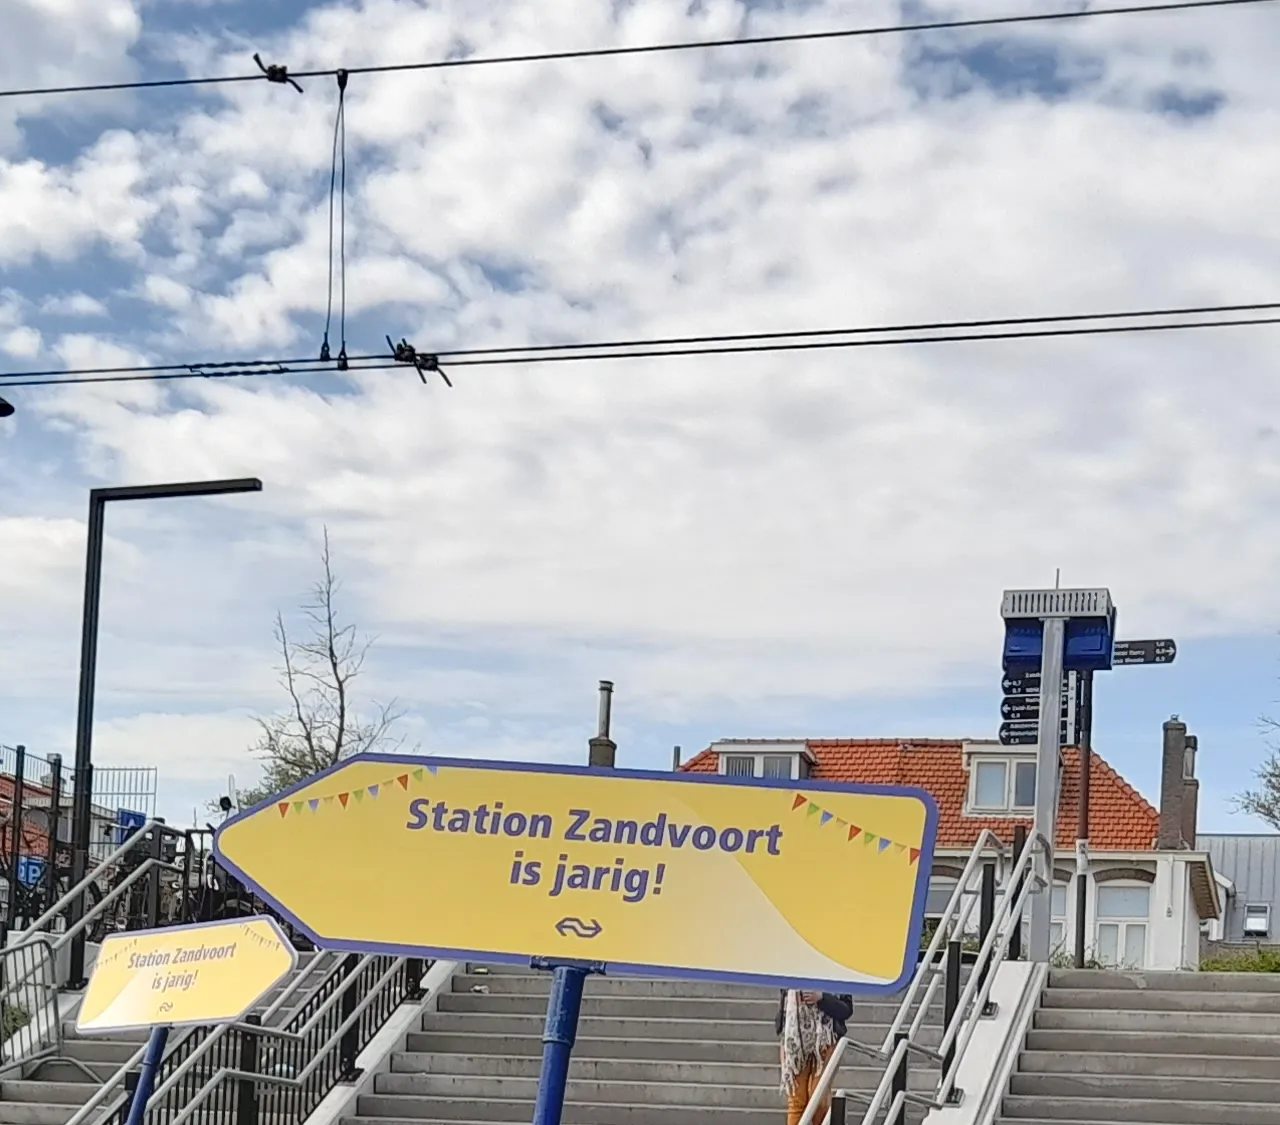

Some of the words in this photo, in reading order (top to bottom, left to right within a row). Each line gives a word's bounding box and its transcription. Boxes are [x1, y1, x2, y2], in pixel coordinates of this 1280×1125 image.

[405, 797, 553, 839] Station
[563, 808, 783, 856] Zandvoort
[509, 850, 542, 886] is
[548, 853, 666, 903] jarig!
[127, 949, 171, 969] Station
[172, 942, 237, 964] Zandvoort
[151, 972, 162, 990] is
[161, 969, 199, 992] jarig!
